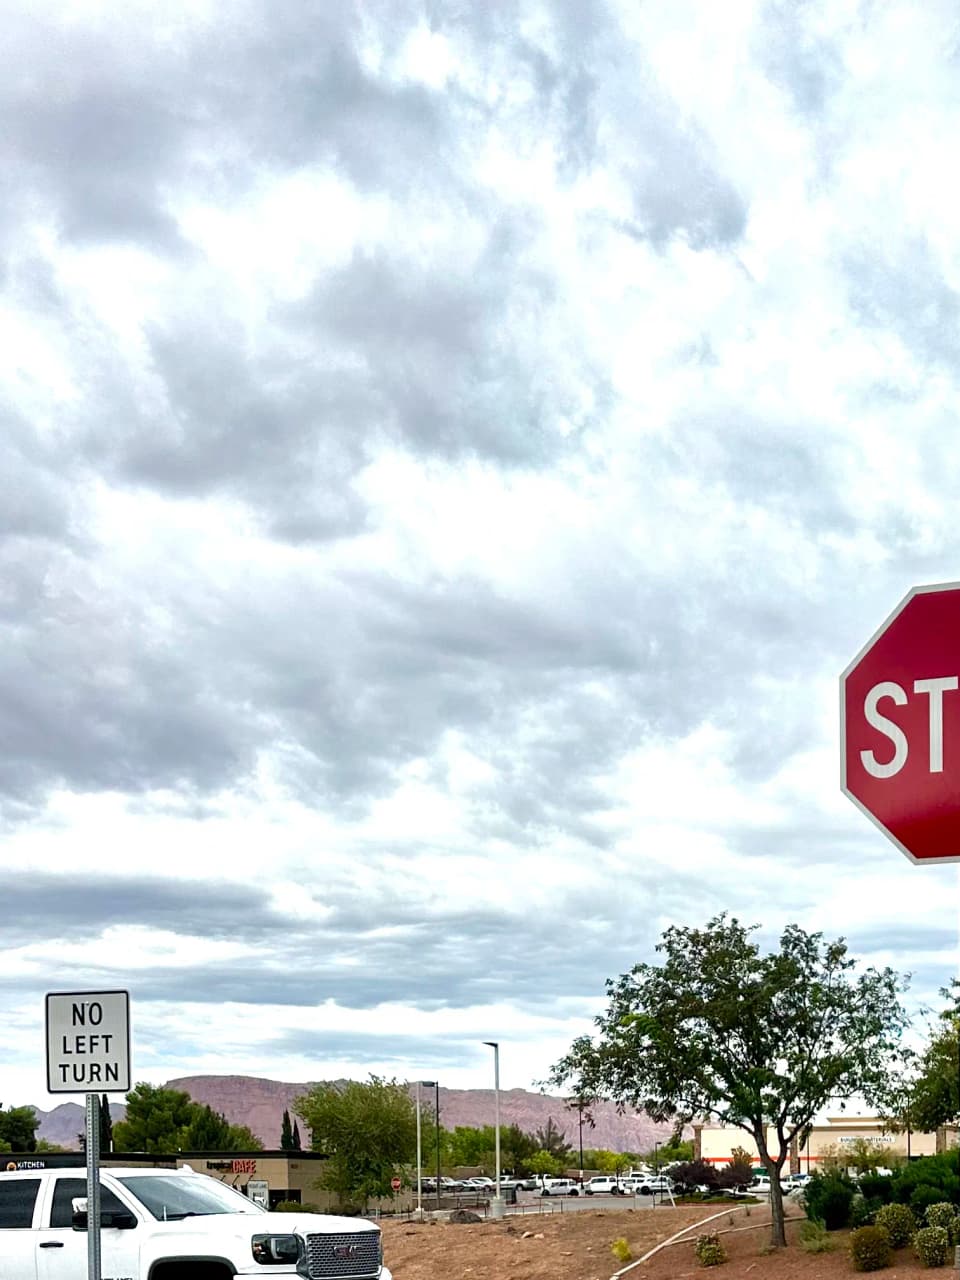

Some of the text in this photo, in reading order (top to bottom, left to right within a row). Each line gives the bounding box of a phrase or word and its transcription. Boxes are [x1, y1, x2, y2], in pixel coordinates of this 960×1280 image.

[72, 1002, 103, 1026] NO
[62, 1034, 113, 1055] LEFT
[58, 1062, 119, 1083] TURN
[17, 1161, 45, 1169] KITCHEN
[231, 1160, 257, 1174] CAFE
